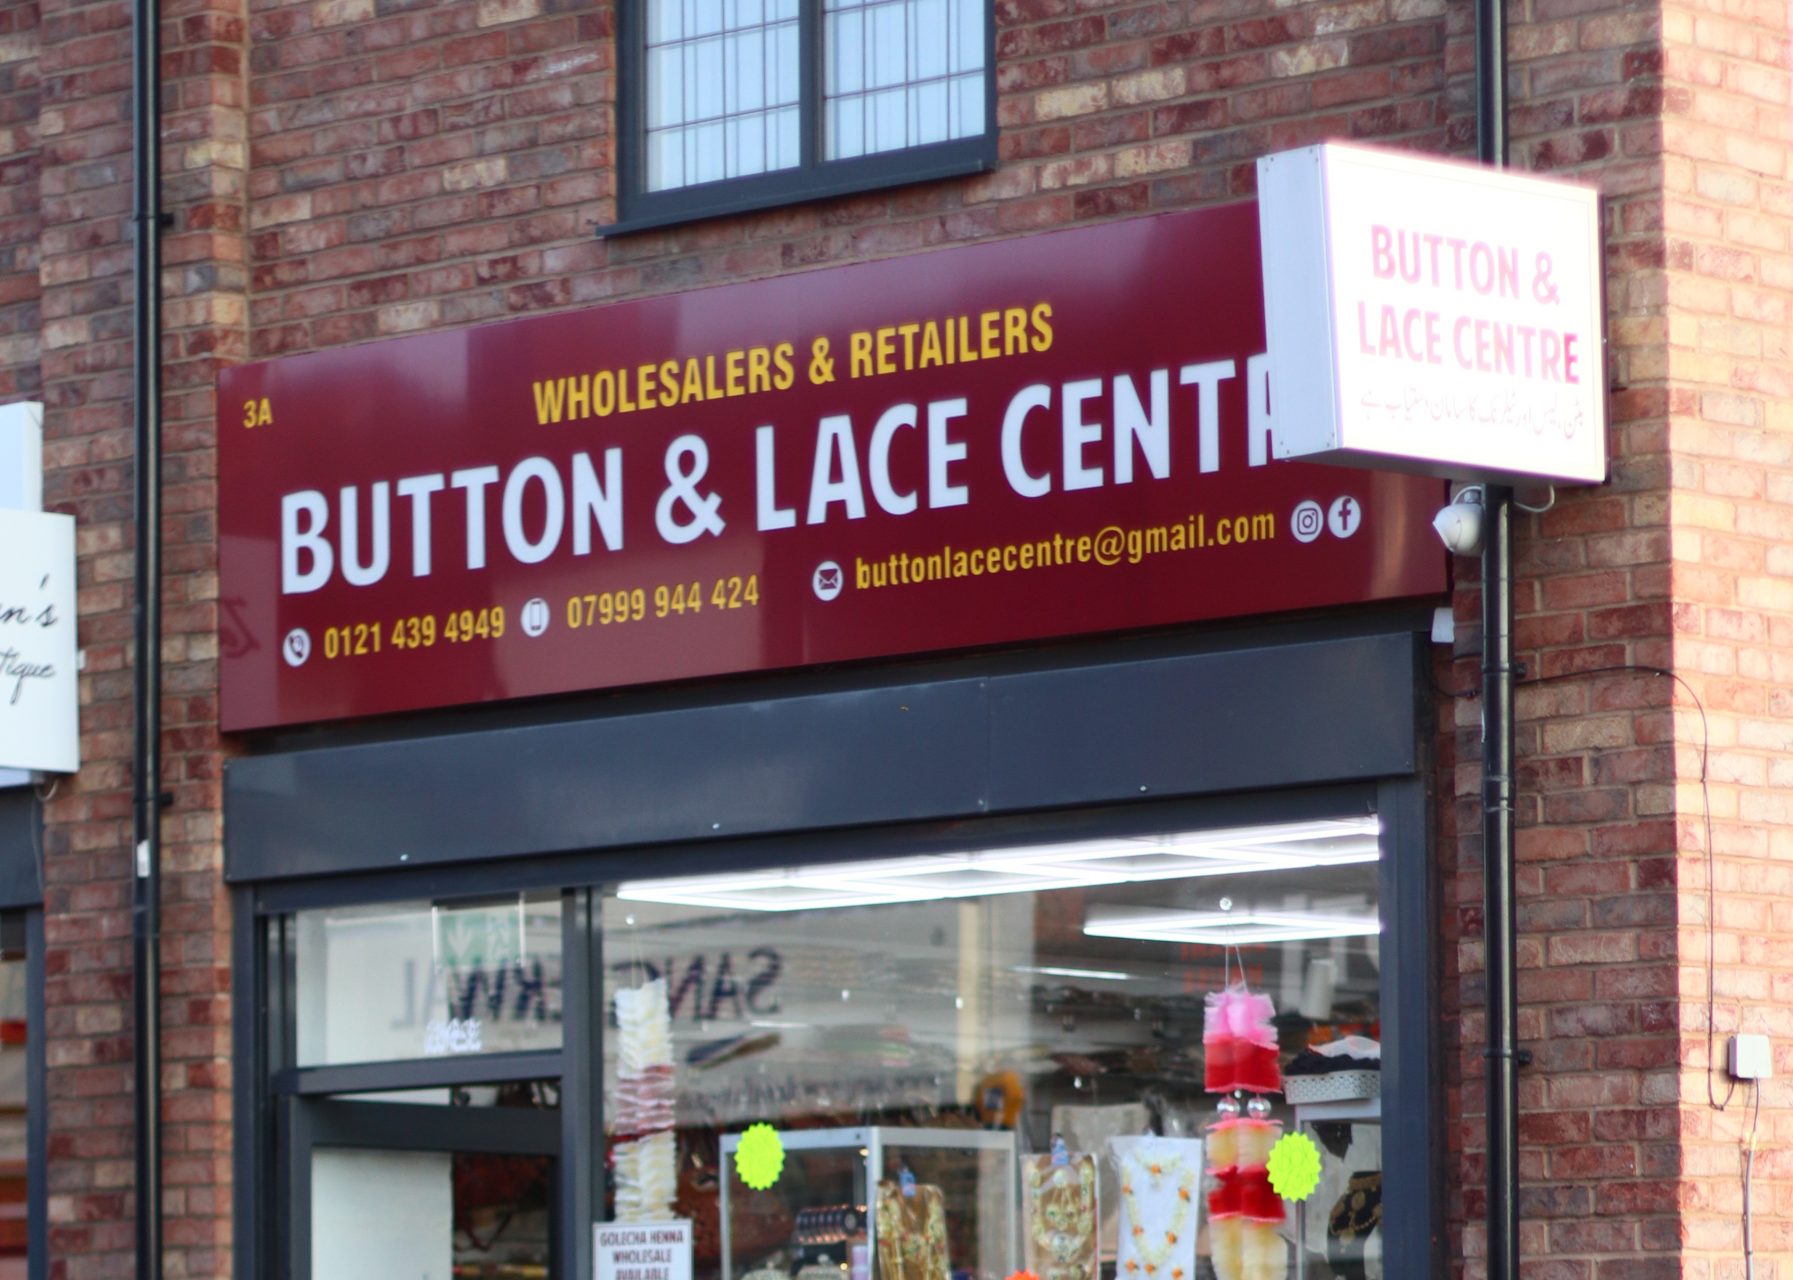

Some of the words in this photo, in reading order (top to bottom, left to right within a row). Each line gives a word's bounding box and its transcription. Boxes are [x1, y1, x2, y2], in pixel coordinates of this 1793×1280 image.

[1370, 223, 1520, 299] BUTTON
[1531, 251, 1561, 306] &
[533, 342, 795, 425] WHOLESALERS
[808, 336, 836, 385] &
[850, 303, 1054, 378] RETAILERS
[1357, 300, 1443, 365] LACE
[1452, 314, 1581, 385] CENTRE
[243, 398, 273, 428] 3A
[281, 447, 624, 595] BUTTON
[655, 434, 726, 545] &
[756, 398, 969, 532] LACE
[1001, 353, 1274, 498] CENT
[855, 511, 1275, 590] buttonlacecentre@gmail.com
[324, 623, 381, 659] 0121
[391, 615, 436, 648] 439
[444, 606, 505, 641] 4949
[566, 588, 645, 628] 07999
[654, 582, 701, 617] 944
[711, 575, 759, 609] 424
[600, 1231, 647, 1247] GOLECHA
[650, 1229, 684, 1244] HENNA
[613, 1249, 672, 1264] WHOLESALE
